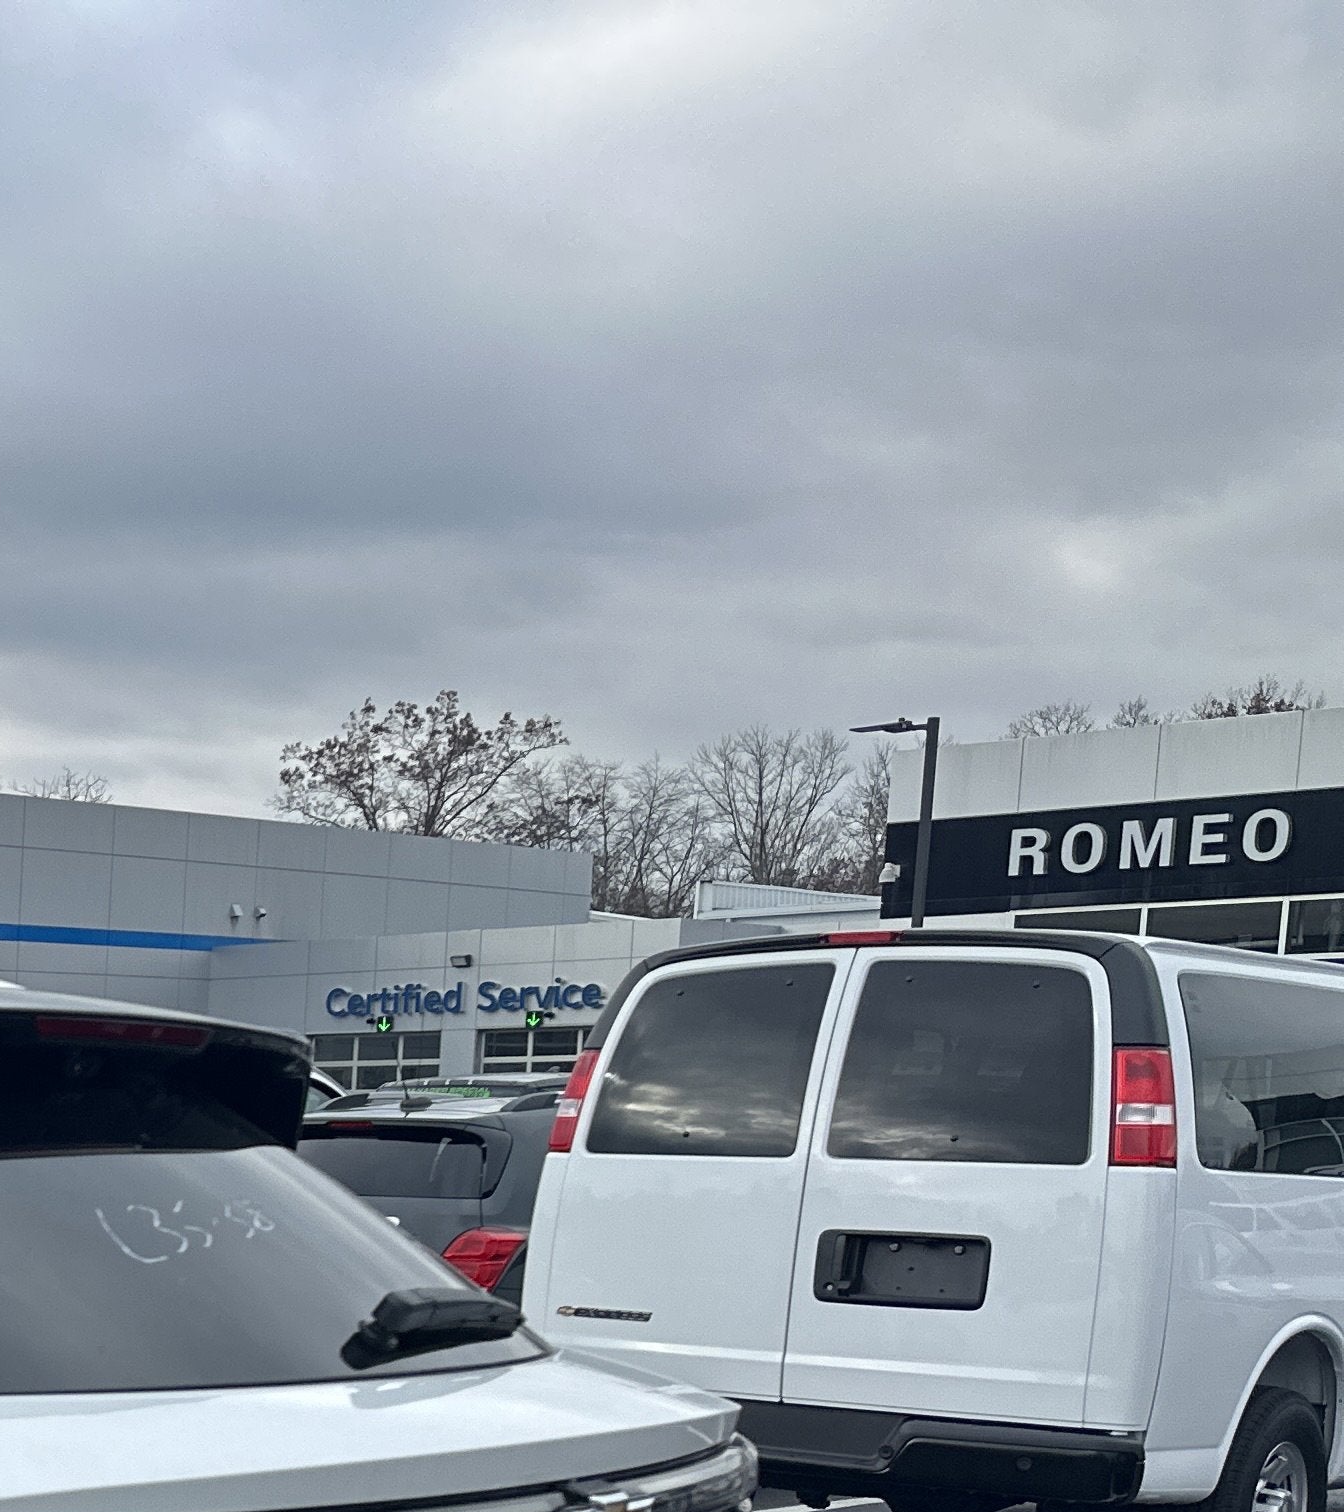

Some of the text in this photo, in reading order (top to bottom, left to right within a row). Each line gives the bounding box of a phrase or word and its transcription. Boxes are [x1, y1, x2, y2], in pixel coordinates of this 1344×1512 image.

[1008, 807, 1293, 877] ROMEO
[325, 977, 605, 1018] Certified Service
